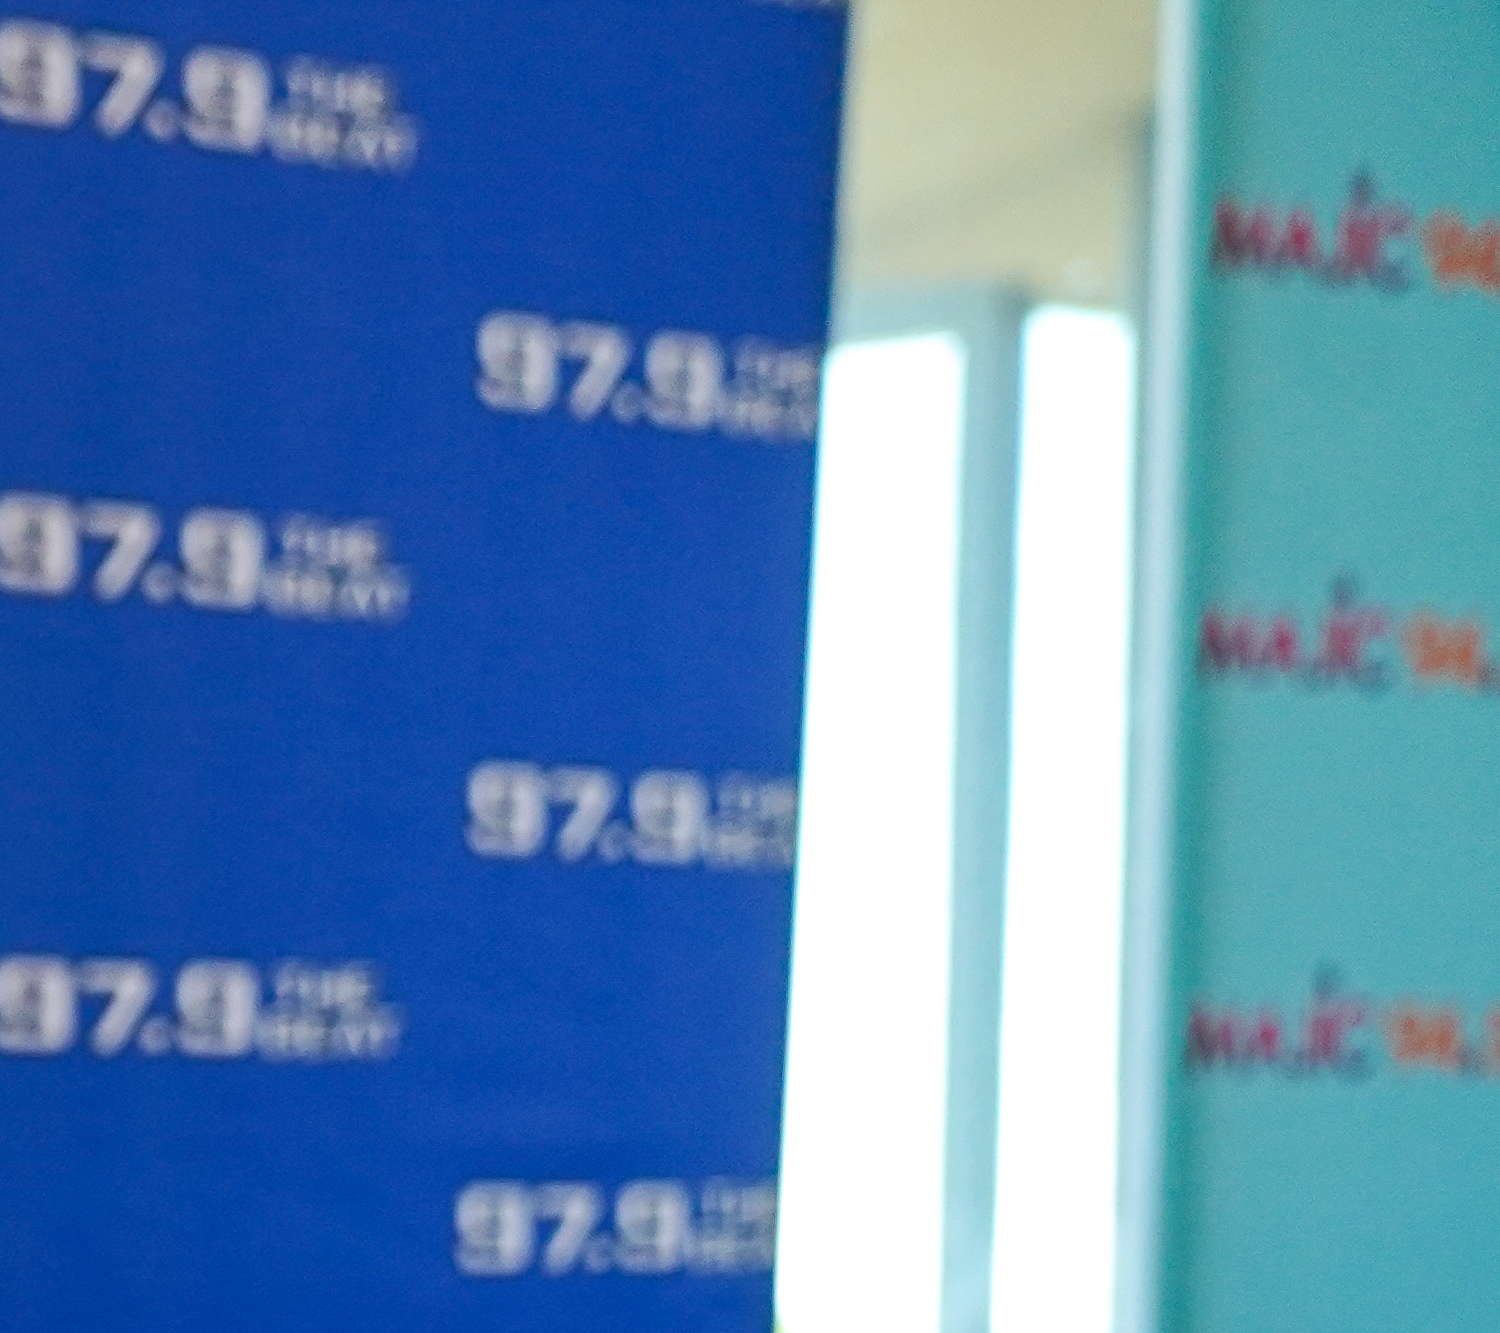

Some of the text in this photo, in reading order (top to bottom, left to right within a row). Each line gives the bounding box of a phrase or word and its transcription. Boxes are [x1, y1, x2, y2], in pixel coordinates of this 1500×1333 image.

[477, 312, 719, 430] 97.9
[465, 762, 709, 865] 97.9
[454, 1180, 690, 1275] 97.9
